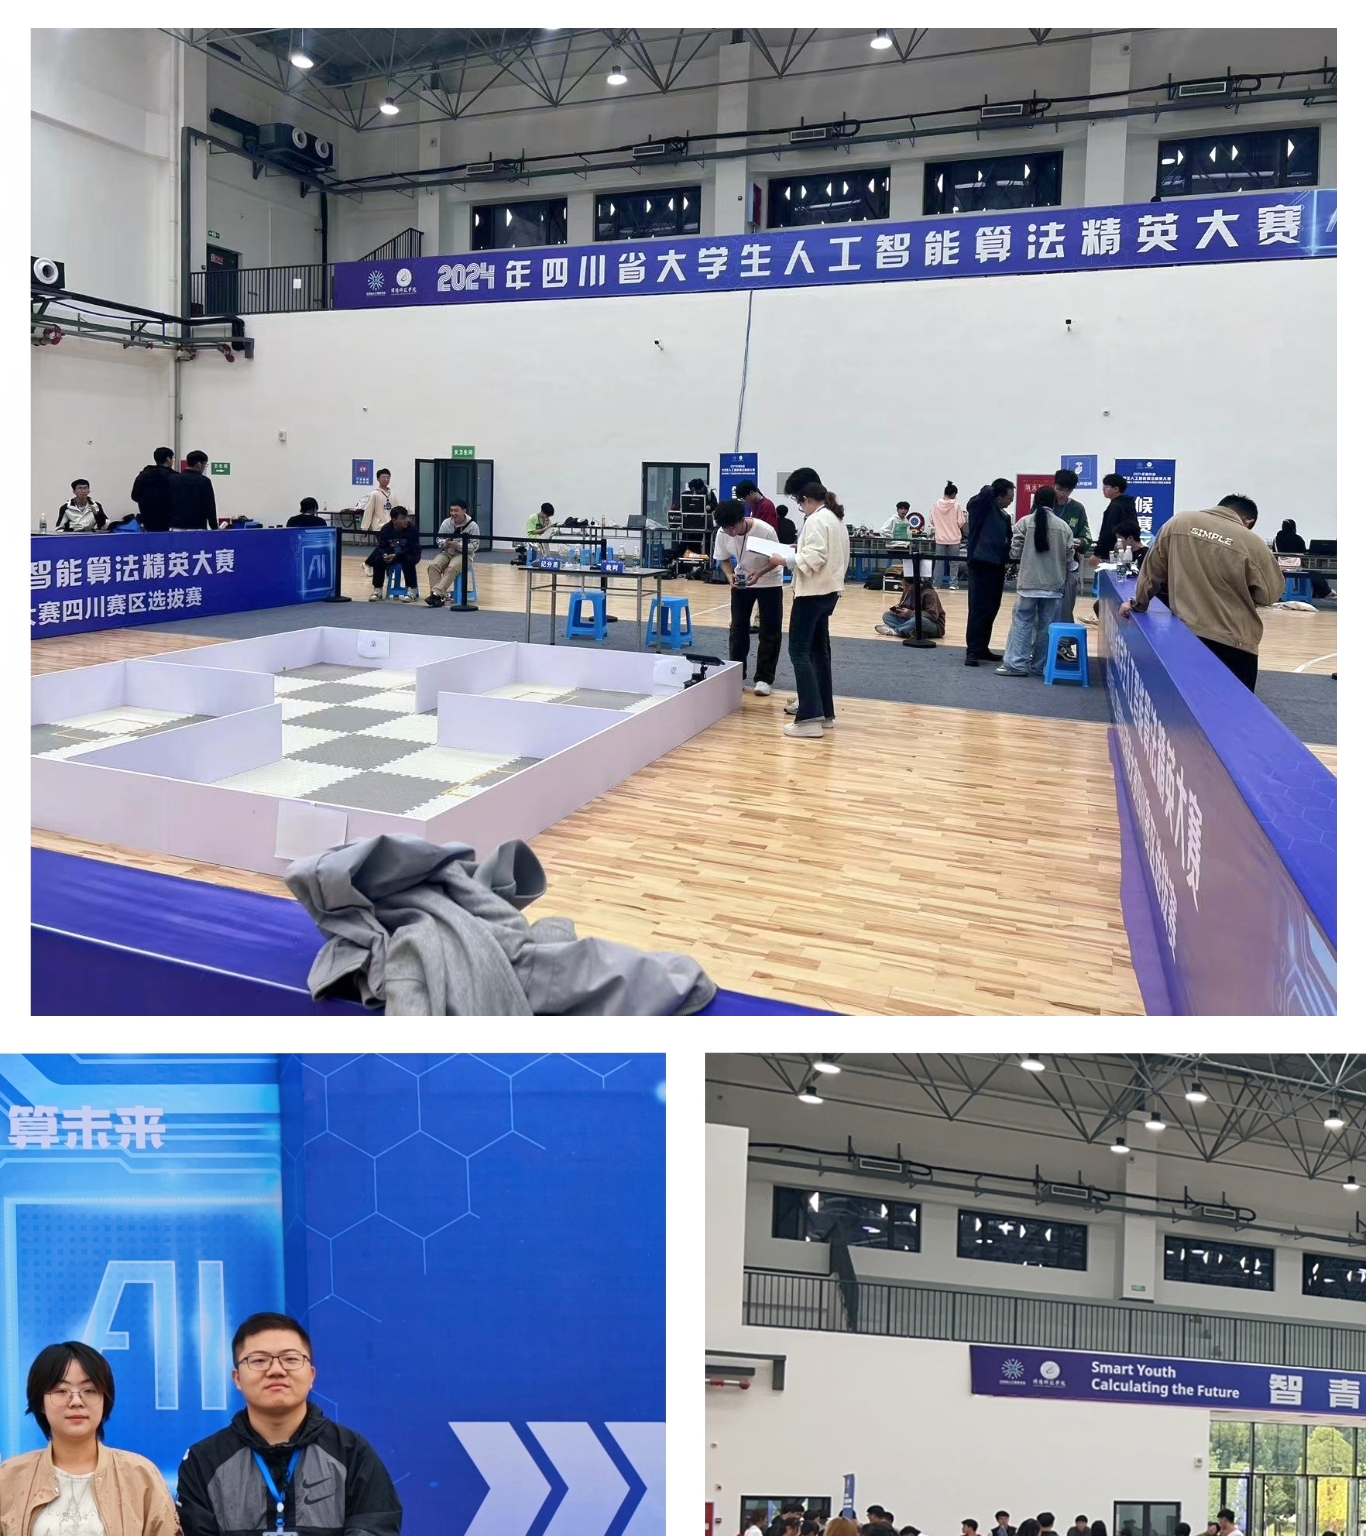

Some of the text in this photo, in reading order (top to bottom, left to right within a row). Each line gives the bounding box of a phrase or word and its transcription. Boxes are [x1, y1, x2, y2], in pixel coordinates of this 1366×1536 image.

[1190, 527, 1233, 546] SIMPLE
[31, 549, 234, 590] 智能算法精英大赛
[307, 554, 326, 580] AI
[1091, 1361, 1176, 1378] Smart Youth
[1091, 1378, 1240, 1398] Calculating the Future
